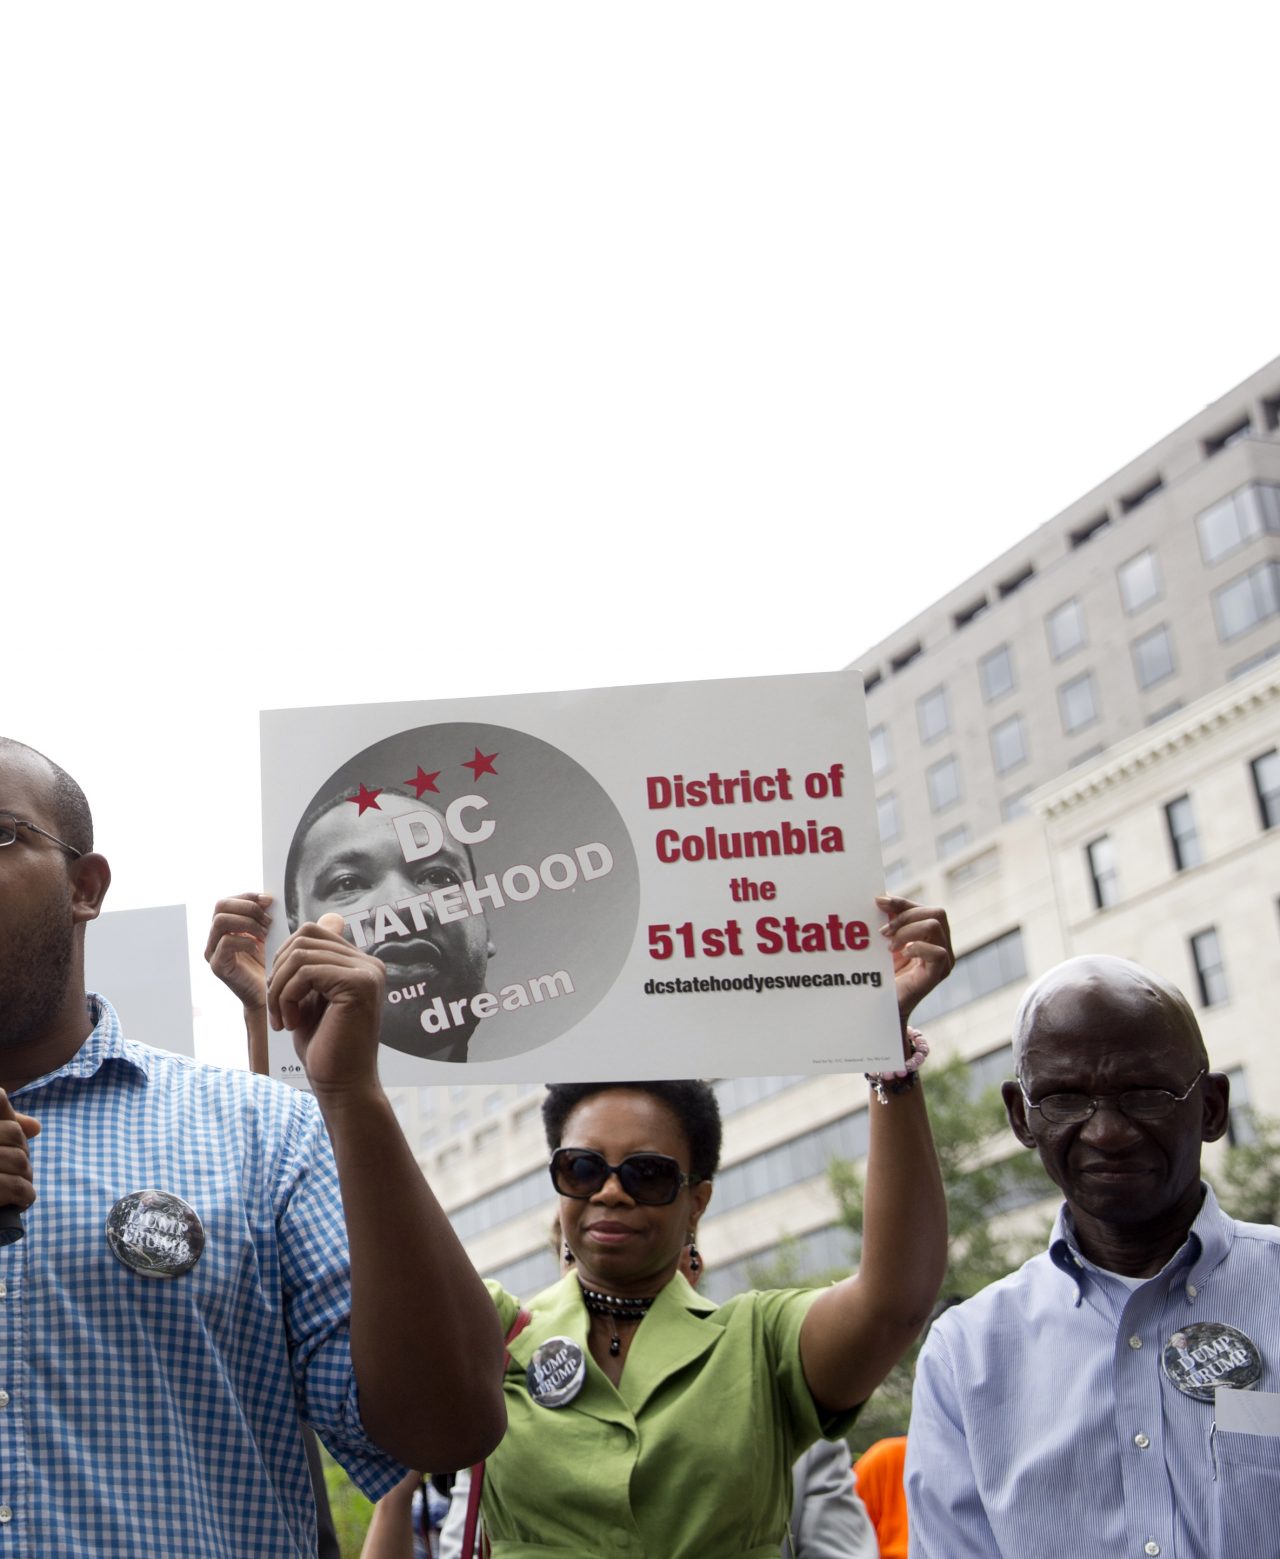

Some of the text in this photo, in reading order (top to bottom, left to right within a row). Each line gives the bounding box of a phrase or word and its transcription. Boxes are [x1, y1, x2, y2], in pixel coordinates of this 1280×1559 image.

[646, 763, 844, 810] District of
[392, 795, 495, 863] DC
[655, 820, 845, 864] Columbia
[342, 842, 614, 948] TATEHOOD
[729, 877, 776, 902] the
[648, 914, 870, 960] 51st State
[388, 982, 426, 1004] our
[420, 969, 575, 1034] dream
[644, 971, 882, 995] dcstatehoodyeswecan.org
[534, 1348, 568, 1383] DUMP
[1177, 1336, 1230, 1371] DUMP
[1184, 1349, 1250, 1388] TRUMP
[536, 1358, 577, 1396] TRUMP
